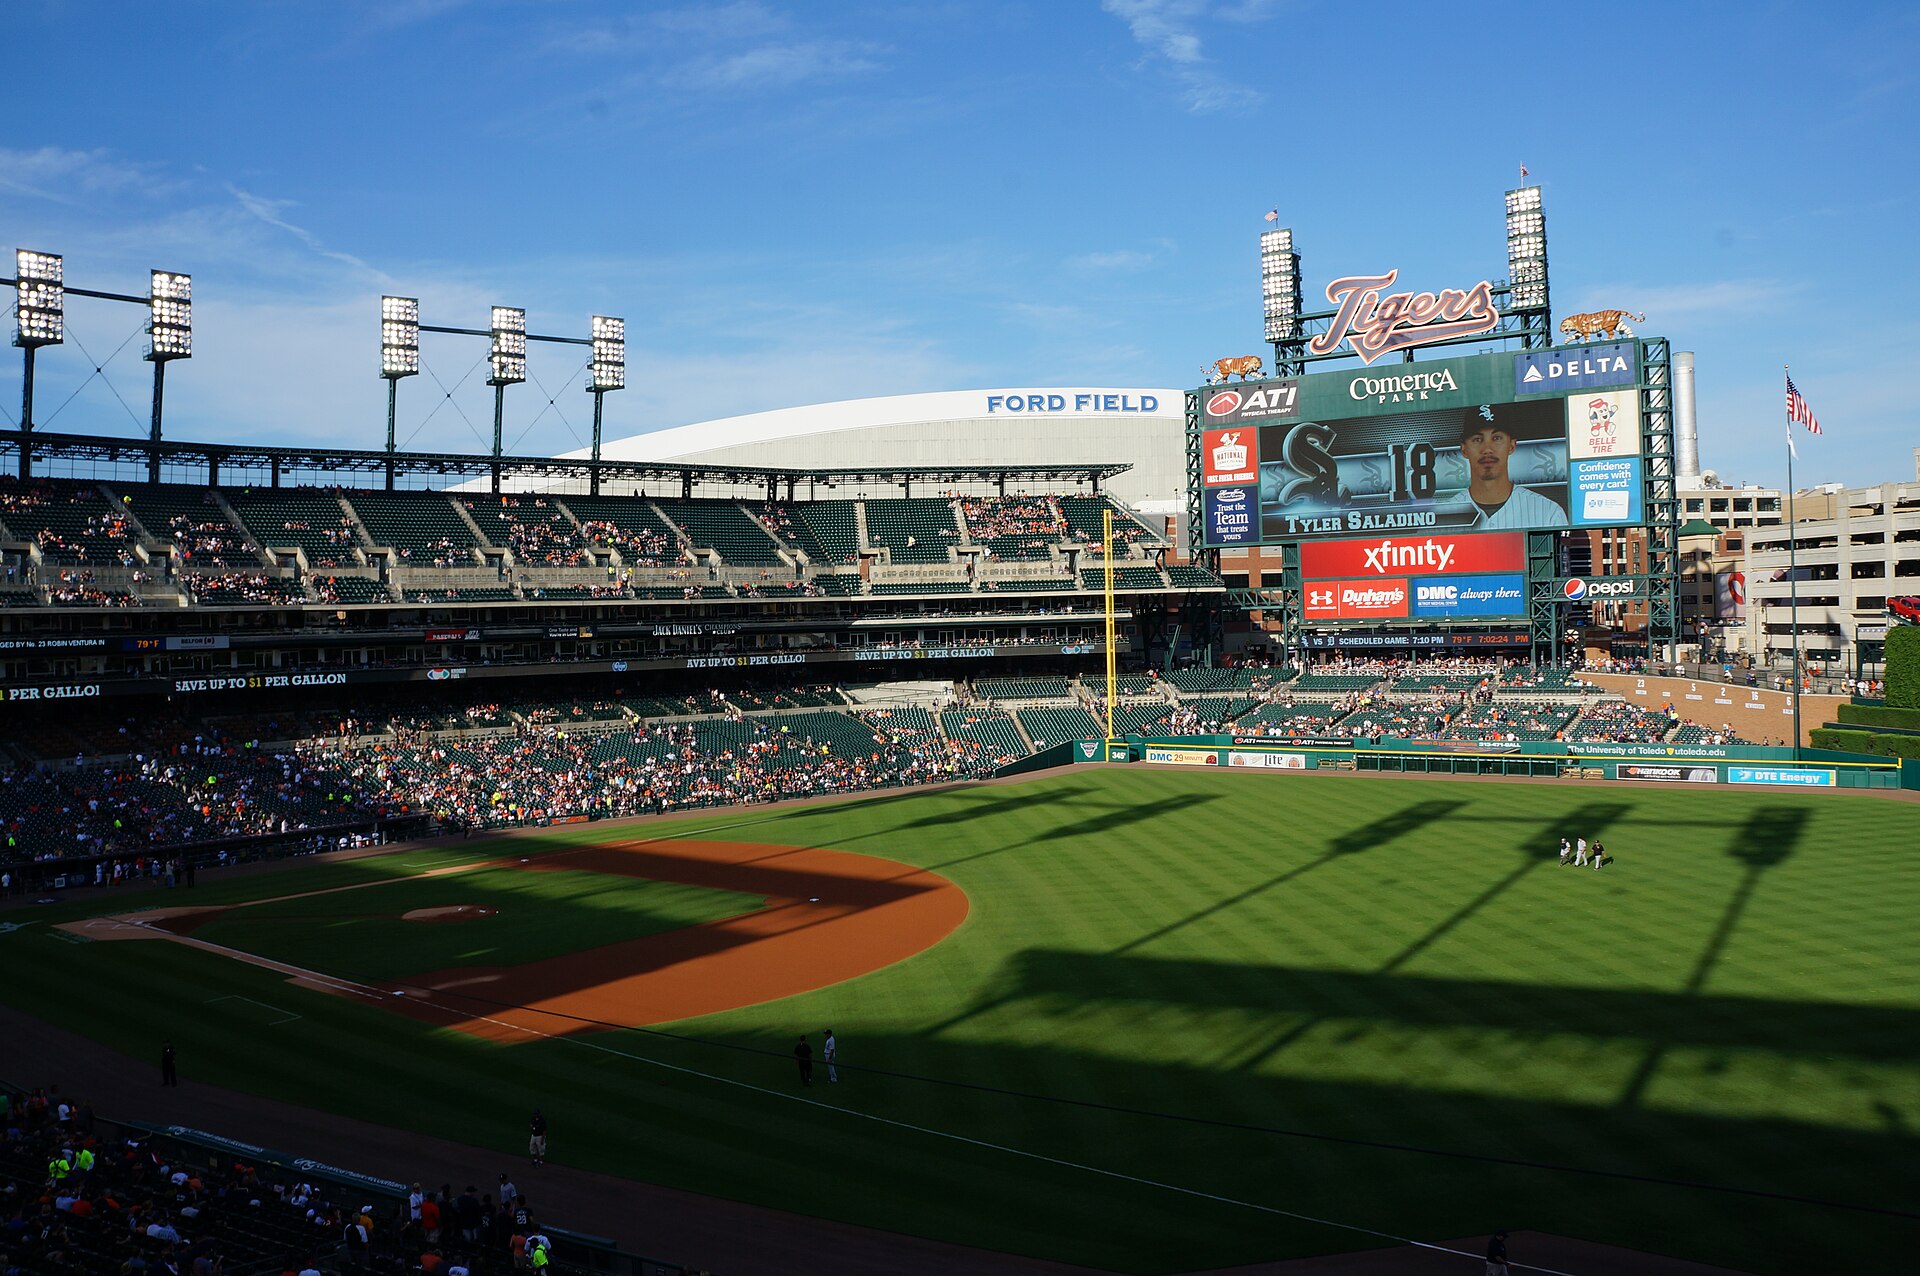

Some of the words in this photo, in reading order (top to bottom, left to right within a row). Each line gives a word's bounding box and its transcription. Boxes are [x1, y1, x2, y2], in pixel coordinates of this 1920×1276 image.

[1310, 269, 1499, 365] Tigers
[1548, 356, 1628, 378] DELTA
[1241, 386, 1298, 410] ATI
[1379, 390, 1429, 404] PARK
[986, 394, 1066, 414] FORD
[1074, 393, 1159, 413] FIELD
[1589, 437, 1616, 446] BELLE
[1593, 445, 1612, 453] TIRE
[1216, 450, 1244, 461] NATIONAL
[1388, 441, 1437, 502] 18
[1579, 462, 1631, 472] Confidence
[1579, 473, 1609, 481] comes
[1611, 470, 1631, 479] with
[1579, 482, 1605, 491] every
[1216, 504, 1234, 512] Trust
[1234, 502, 1246, 511] the
[1213, 511, 1249, 525] Team
[1285, 514, 1342, 533] TYLER
[1350, 510, 1436, 529] SALADINO
[1216, 526, 1229, 534] that
[1229, 525, 1249, 533] treats
[1222, 533, 1242, 542] yours
[1363, 538, 1455, 573] xfinity
[1417, 585, 1458, 600] DMC
[1459, 588, 1493, 601] always
[1494, 588, 1522, 598] there.
[1588, 579, 1634, 596] pepsi
[1342, 587, 1405, 603] Dunham's
[652, 624, 671, 636] JACK
[672, 624, 703, 635] DANIEL'S
[704, 623, 742, 631] CHAMPIONS
[68, 639, 98, 647] VENTURA
[1338, 637, 1384, 645] SCHEDULED
[1384, 636, 1410, 645] GAME:
[1412, 636, 1429, 644] 7:10
[1430, 636, 1444, 644] PM
[1478, 635, 1509, 643] 7:02:24
[1515, 635, 1529, 643] PM
[855, 651, 880, 661] SAVE
[882, 651, 896, 660] UP
[896, 650, 912, 659] TO
[914, 650, 926, 659] $1
[927, 649, 949, 658] PER
[951, 648, 994, 658] GALLON
[707, 658, 721, 667] UP
[721, 658, 736, 666] TO
[737, 657, 748, 666] $1
[749, 656, 769, 665] PER
[175, 680, 207, 692] SAVE
[209, 679, 227, 690] UP
[228, 678, 246, 689] TO
[249, 677, 262, 688] $1
[264, 676, 290, 687] PER
[291, 673, 346, 686] GALLON
[1637, 679, 1645, 688] 23
[1691, 683, 1696, 692] 5
[9, 687, 40, 701] PER
[1720, 687, 1726, 697] 2
[1786, 696, 1792, 706] 6
[1570, 746, 1585, 754] The
[1586, 746, 1626, 755] University
[1627, 746, 1637, 754] of
[1637, 746, 1666, 755] Toledo
[1675, 748, 1726, 756] utoledo.edu
[1149, 752, 1173, 761] DMC
[1174, 753, 1184, 762] 29
[1264, 754, 1283, 767] Lite
[1754, 771, 1777, 780] DTE
[1780, 772, 1820, 784] Energy
